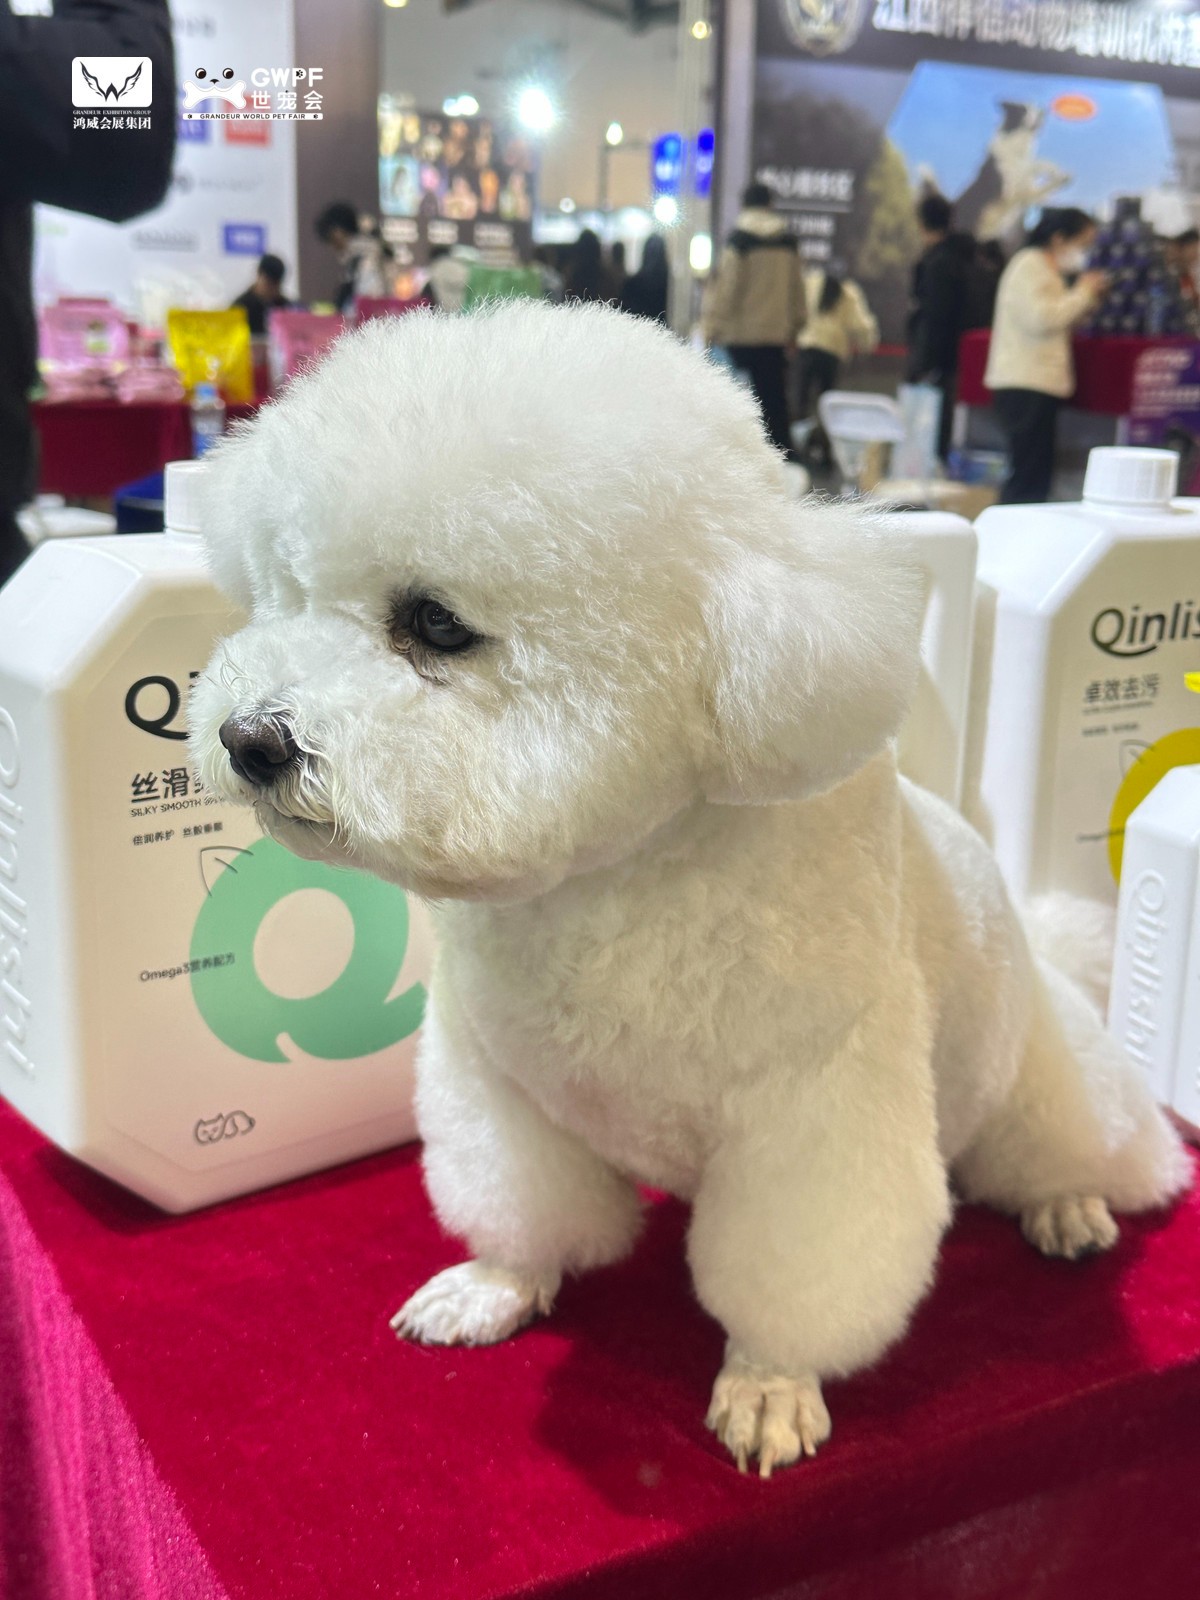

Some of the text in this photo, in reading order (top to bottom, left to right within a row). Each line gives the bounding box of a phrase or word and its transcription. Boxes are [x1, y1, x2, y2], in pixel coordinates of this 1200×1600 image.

[131, 767, 205, 803] 丝滑
[130, 805, 158, 818] SILKY
[160, 798, 202, 813] SMOOTH
